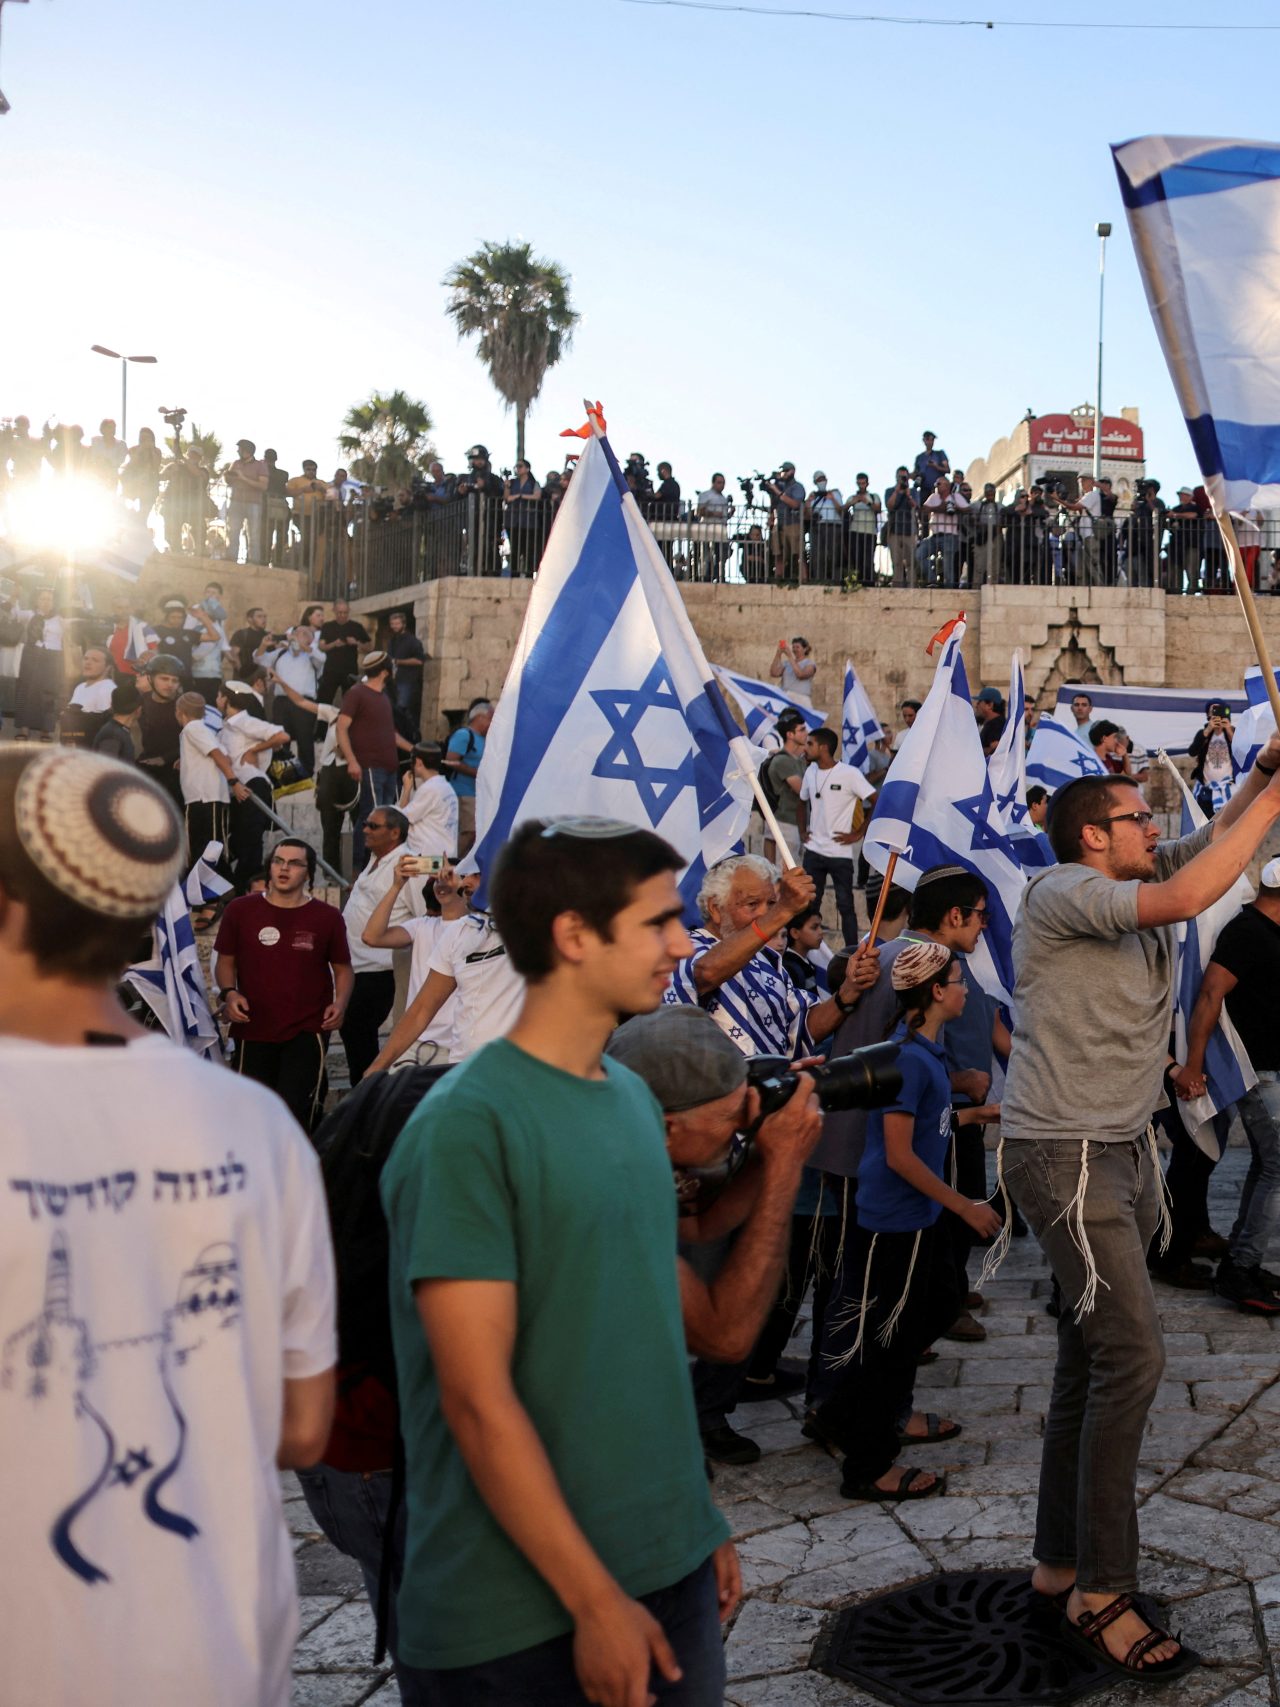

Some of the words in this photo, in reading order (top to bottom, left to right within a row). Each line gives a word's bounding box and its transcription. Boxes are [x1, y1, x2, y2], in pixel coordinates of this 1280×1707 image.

[1077, 445, 1138, 457] RESAURANT
[1091, 430, 1132, 442] مطع
[154, 1151, 246, 1201] לנווה
[10, 1170, 136, 1219] קודשך
